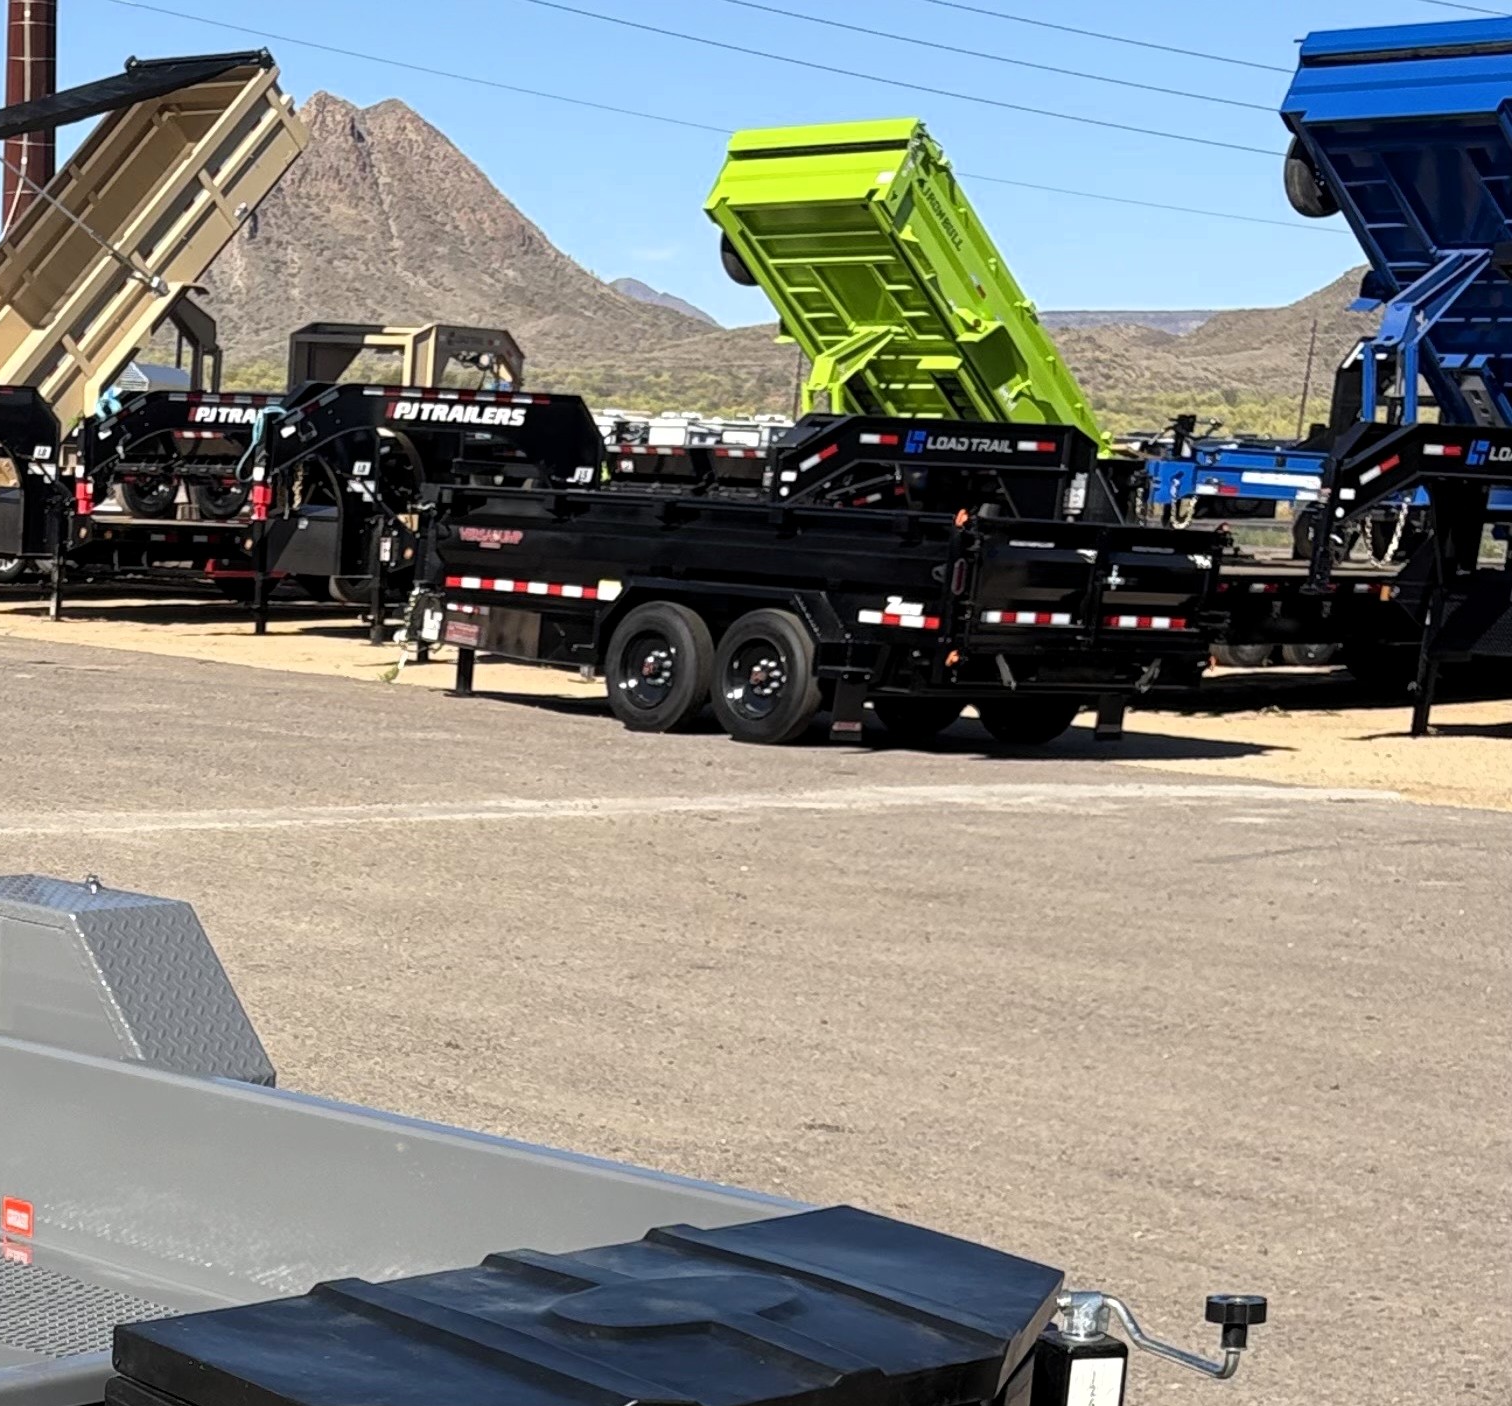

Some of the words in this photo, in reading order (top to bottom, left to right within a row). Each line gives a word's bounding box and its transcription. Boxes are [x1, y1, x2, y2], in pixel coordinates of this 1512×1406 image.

[194, 406, 218, 423] PJ
[393, 402, 420, 420] PJ
[420, 403, 527, 427] TRAILERS
[926, 436, 968, 451] LOAD
[970, 438, 1013, 453] TRAIL
